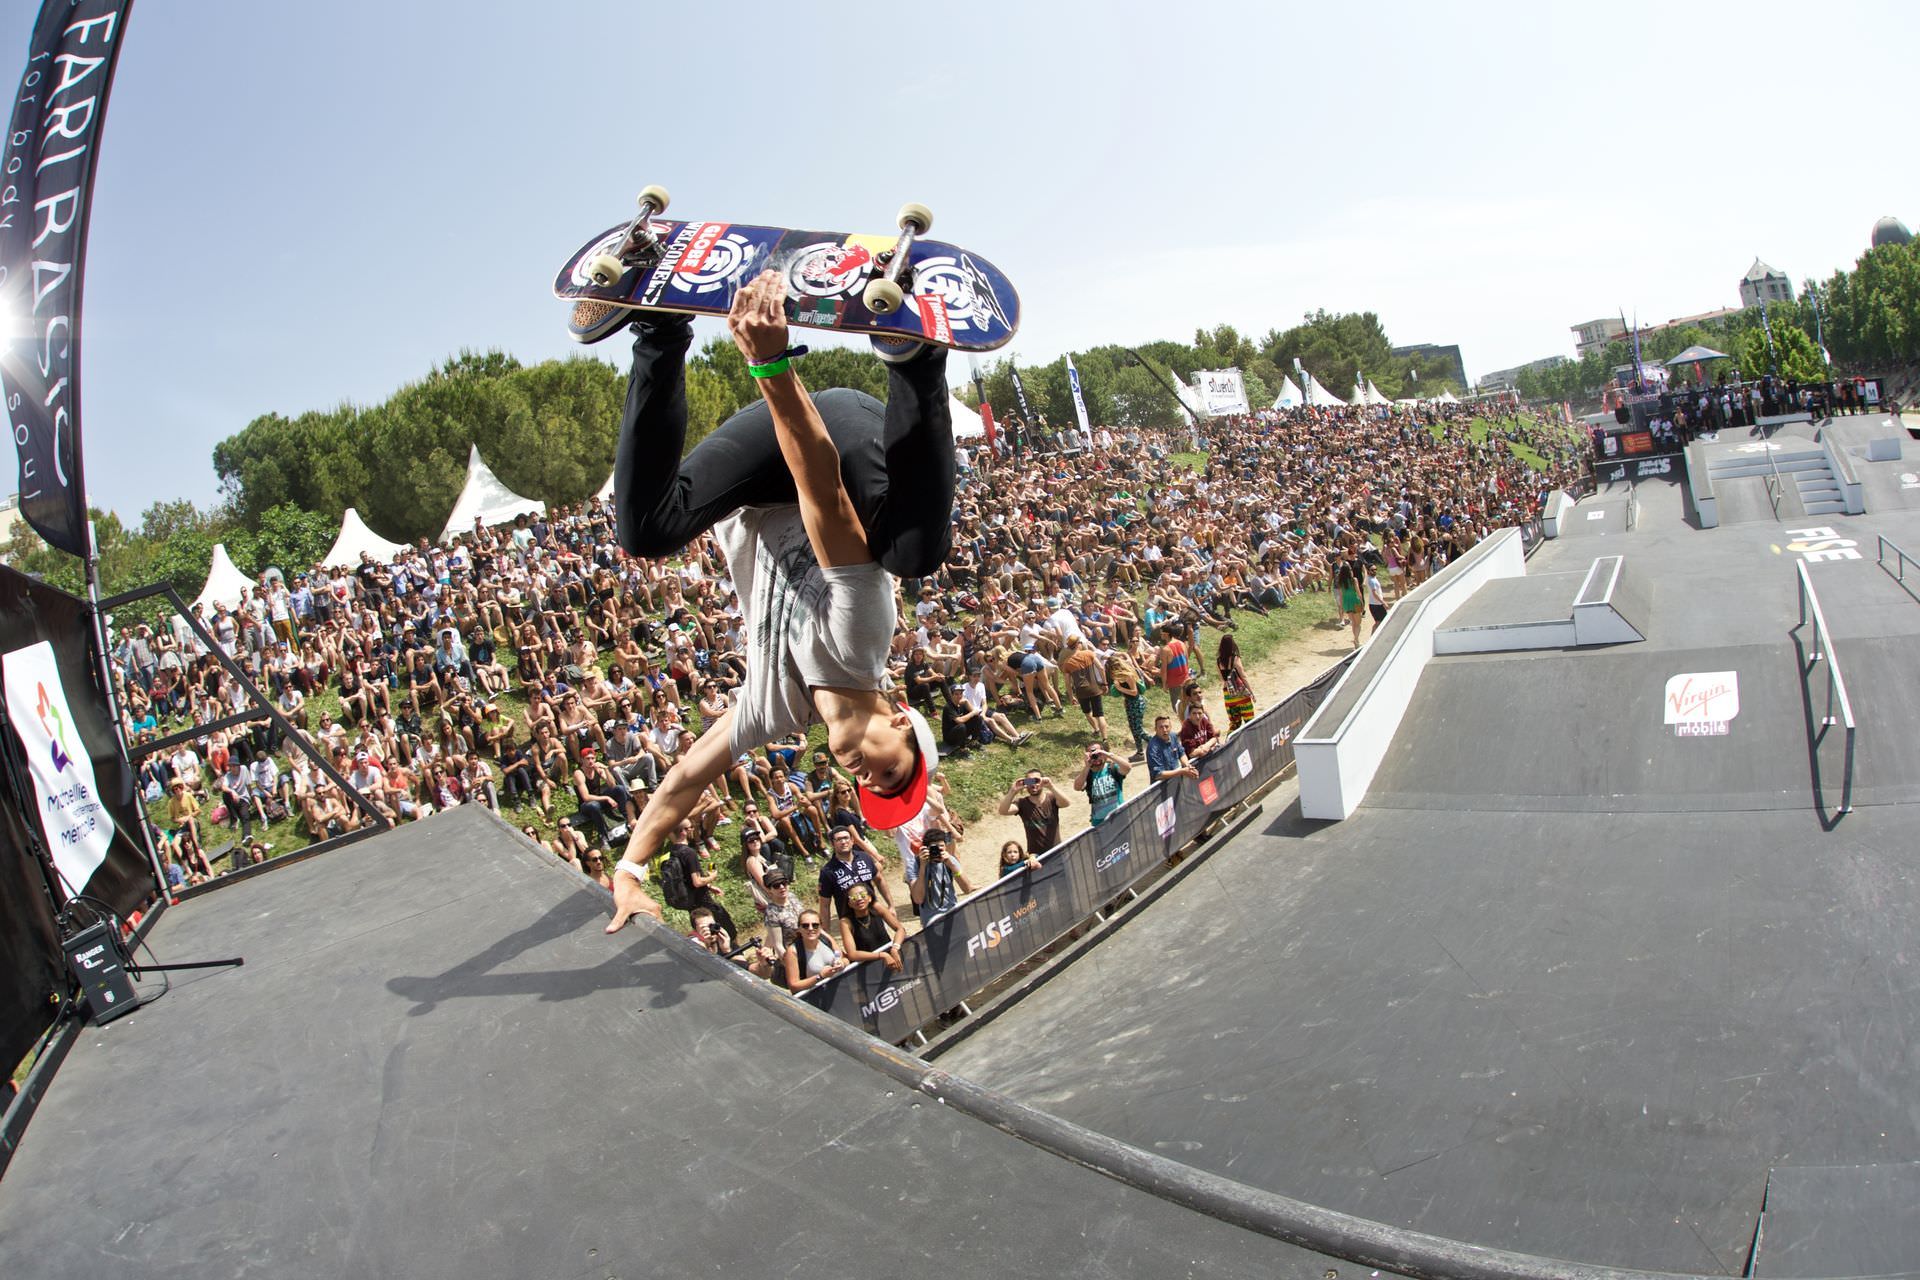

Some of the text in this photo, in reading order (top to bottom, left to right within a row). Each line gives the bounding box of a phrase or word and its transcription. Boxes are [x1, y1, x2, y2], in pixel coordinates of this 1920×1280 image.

[681, 223, 721, 269] GLOBE
[927, 296, 950, 344] THRASHER
[1785, 525, 1863, 563] FISE
[1668, 677, 1733, 717] Virgin
[1271, 725, 1292, 751] FISE
[1678, 720, 1727, 736] mobile
[856, 860, 867, 870] 53
[1095, 841, 1130, 869] GoPro
[966, 915, 1014, 957] FISE
[1012, 898, 1038, 919] World
[75, 944, 105, 964] RANGER
